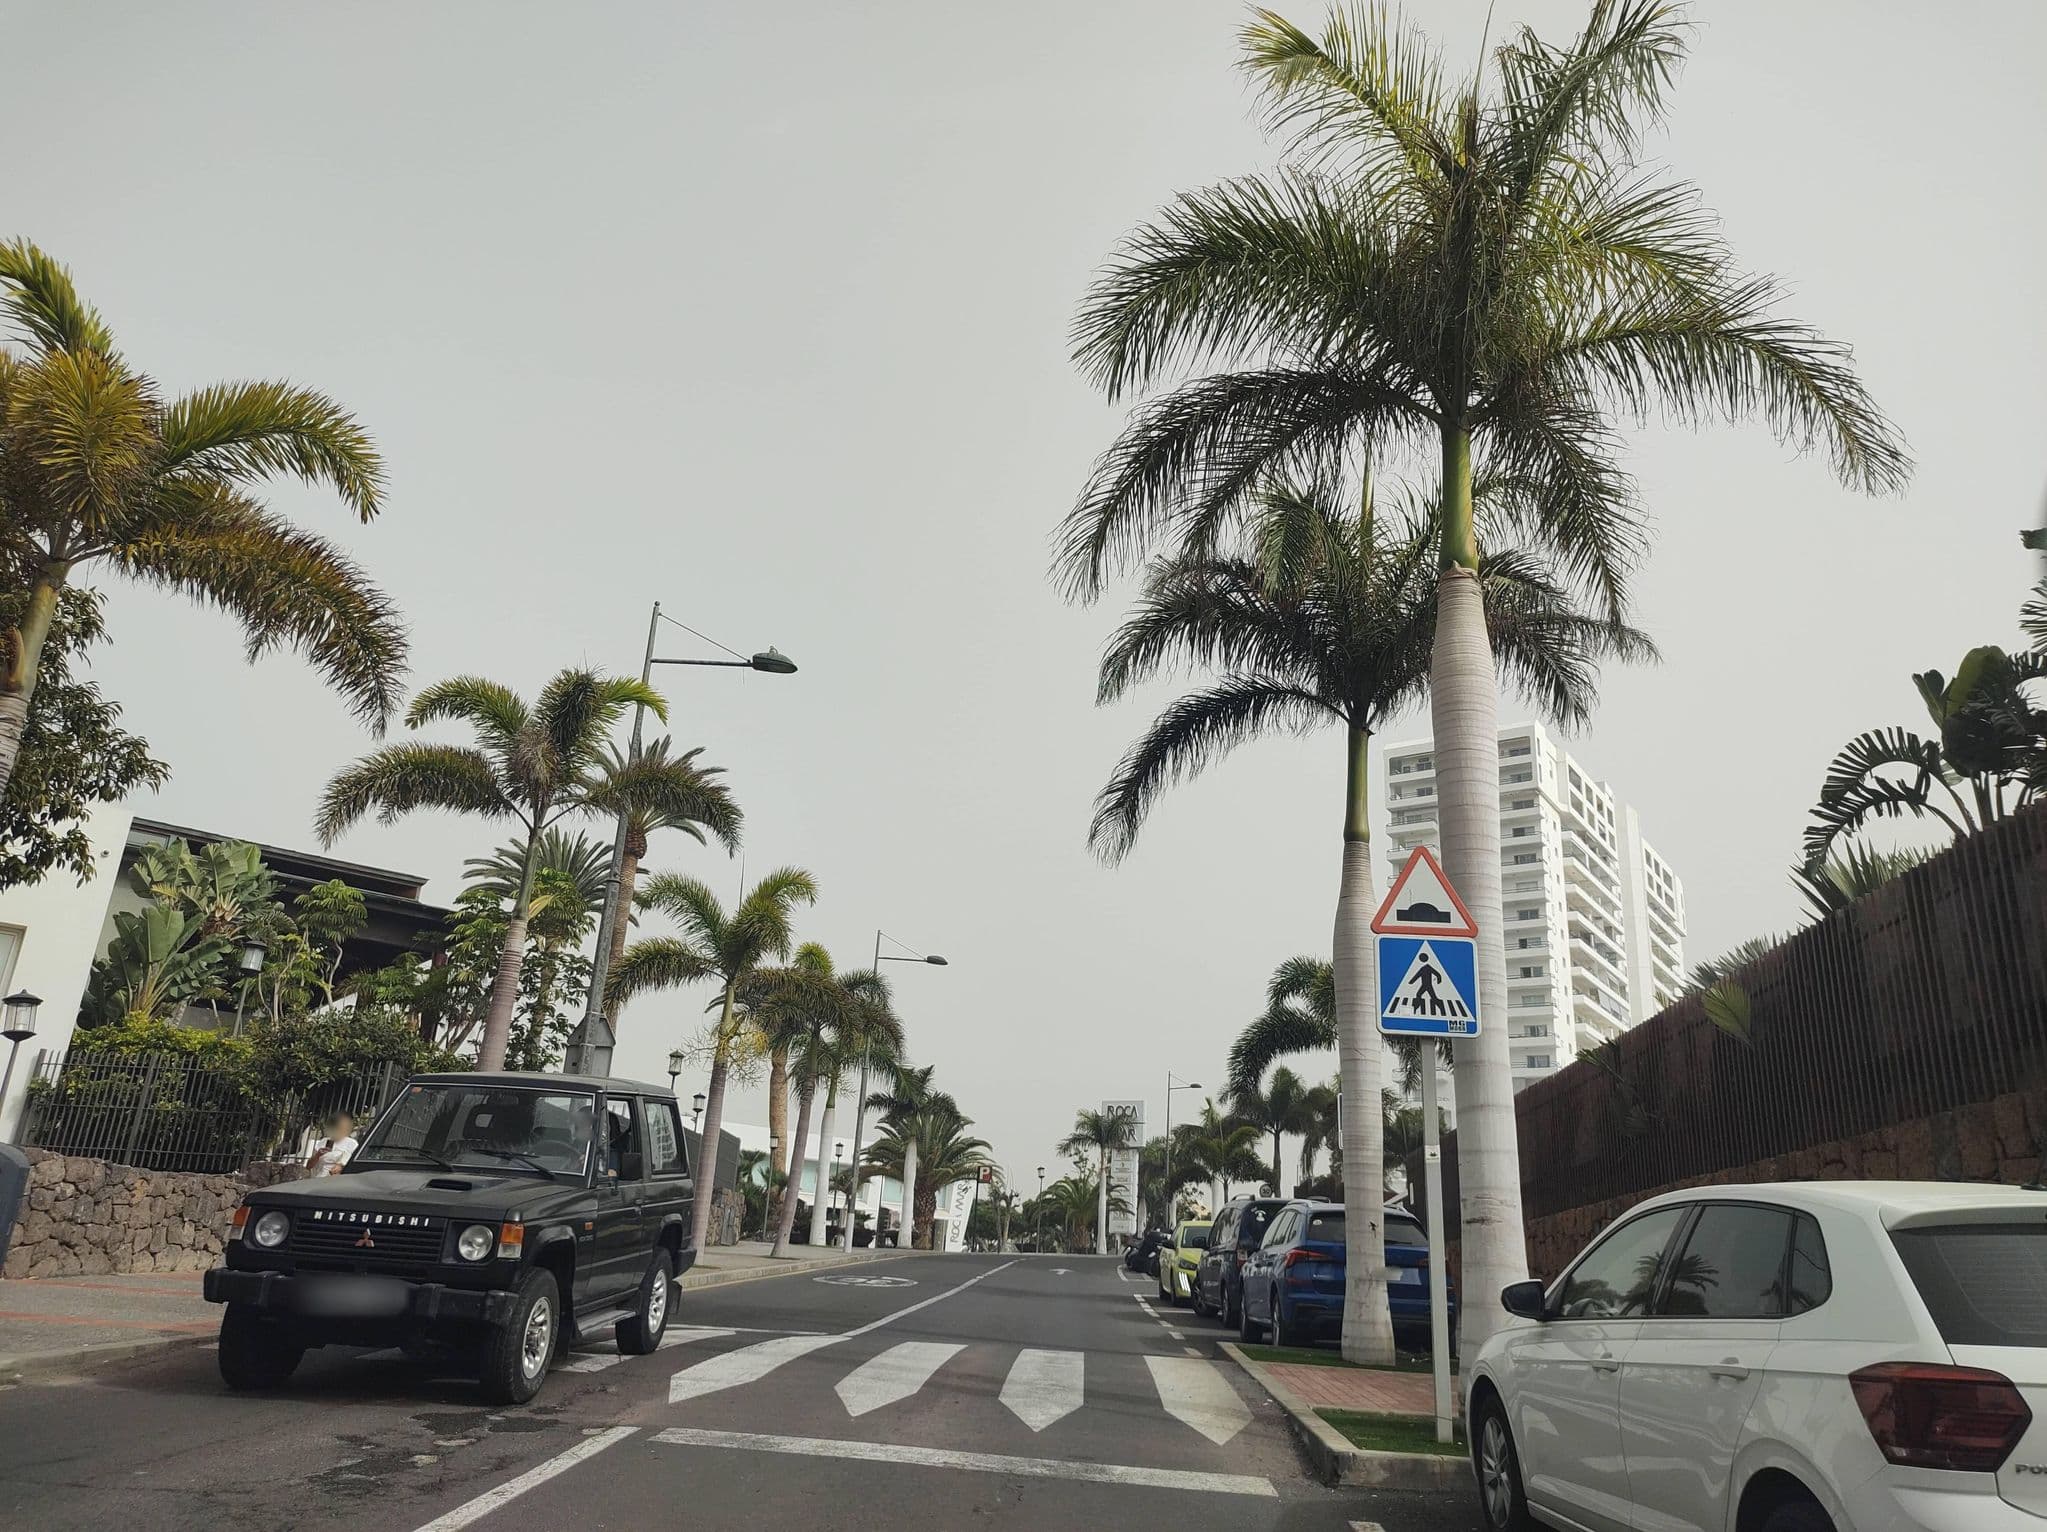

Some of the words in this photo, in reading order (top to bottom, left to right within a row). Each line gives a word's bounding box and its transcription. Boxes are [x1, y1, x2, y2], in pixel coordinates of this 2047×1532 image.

[1107, 1105, 1138, 1117] ROCA
[979, 1166, 989, 1180] P
[313, 1210, 430, 1226] MITSUBISHI
[2015, 1463, 2047, 1475] PO
